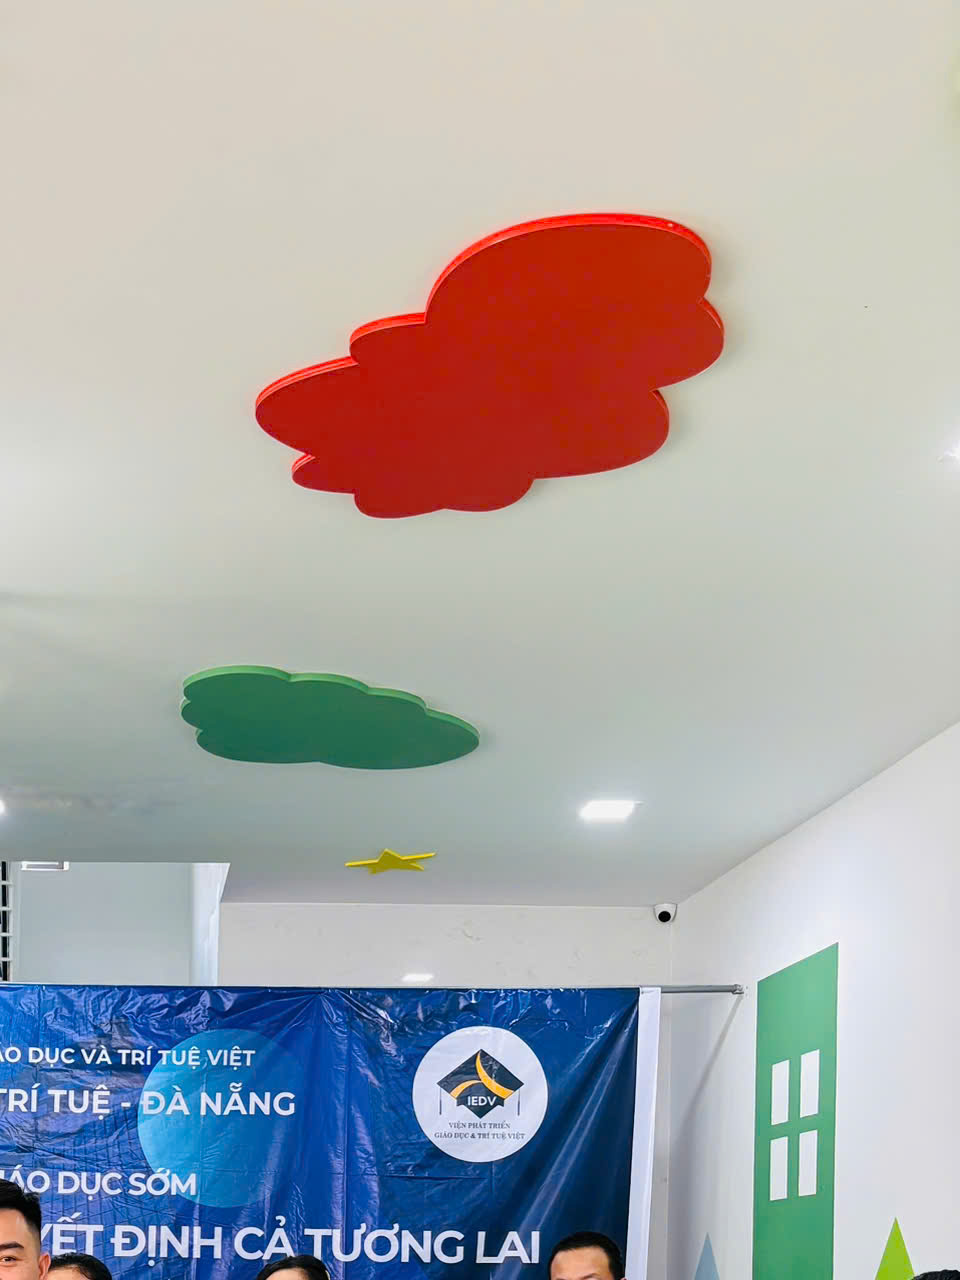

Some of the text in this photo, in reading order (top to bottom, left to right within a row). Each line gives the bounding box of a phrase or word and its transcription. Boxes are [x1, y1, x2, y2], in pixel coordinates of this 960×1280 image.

[28, 1047, 75, 1067] DỤC
[81, 1045, 112, 1065] VÀ
[118, 1046, 153, 1066] TRÍ
[158, 1046, 201, 1070] TUỆ
[206, 1046, 256, 1071] VIỆT
[48, 1084, 111, 1120] TUỆ
[140, 1085, 190, 1116] ĐÀ
[200, 1082, 296, 1116] NẴNG
[467, 1096, 497, 1106] IEDV
[58, 1171, 123, 1201] DỤC
[128, 1168, 197, 1196] SỚM
[110, 1224, 222, 1267] ĐỊNH
[234, 1216, 295, 1260] CẢ
[304, 1222, 465, 1264] TƯƠNG
[476, 1231, 540, 1264] LAI
